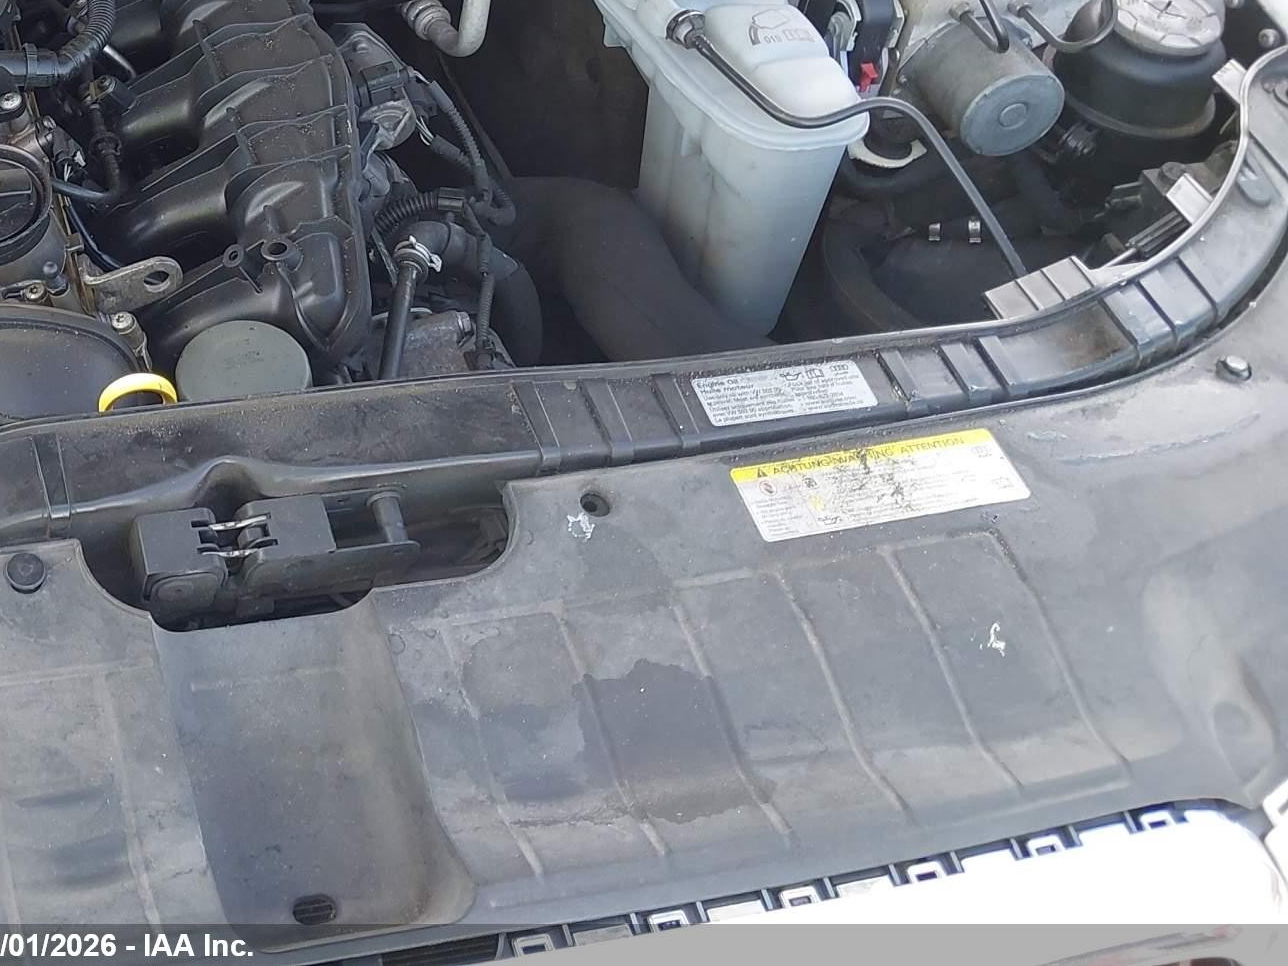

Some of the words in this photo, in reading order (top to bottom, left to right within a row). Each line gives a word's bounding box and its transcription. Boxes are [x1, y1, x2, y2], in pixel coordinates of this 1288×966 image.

[696, 380, 725, 388] Engine
[773, 455, 831, 475] ACHTUNG
[900, 436, 965, 455] ATTENTION
